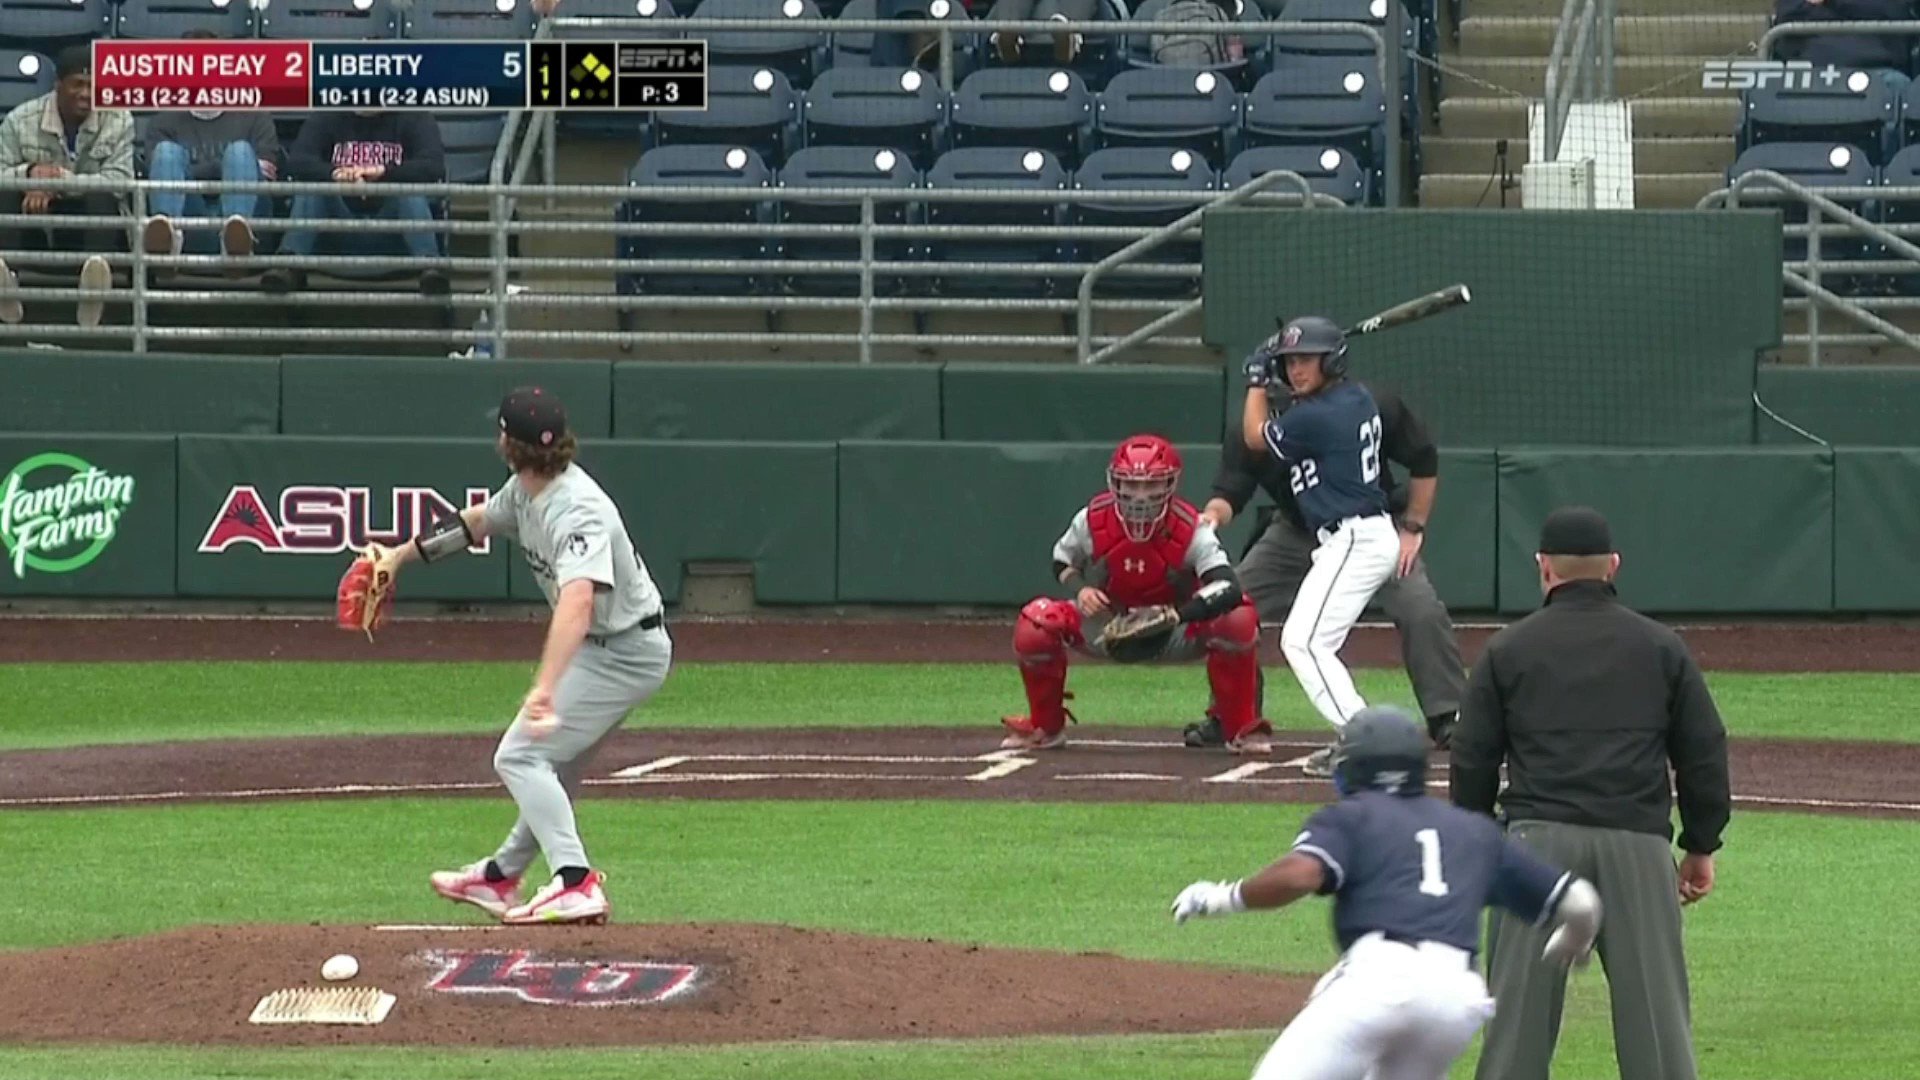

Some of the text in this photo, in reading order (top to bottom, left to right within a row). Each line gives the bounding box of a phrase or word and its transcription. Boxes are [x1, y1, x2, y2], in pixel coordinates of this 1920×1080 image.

[1290, 458, 1320, 496] 22
[9, 508, 121, 579] Farms
[1415, 829, 1449, 897] 1
